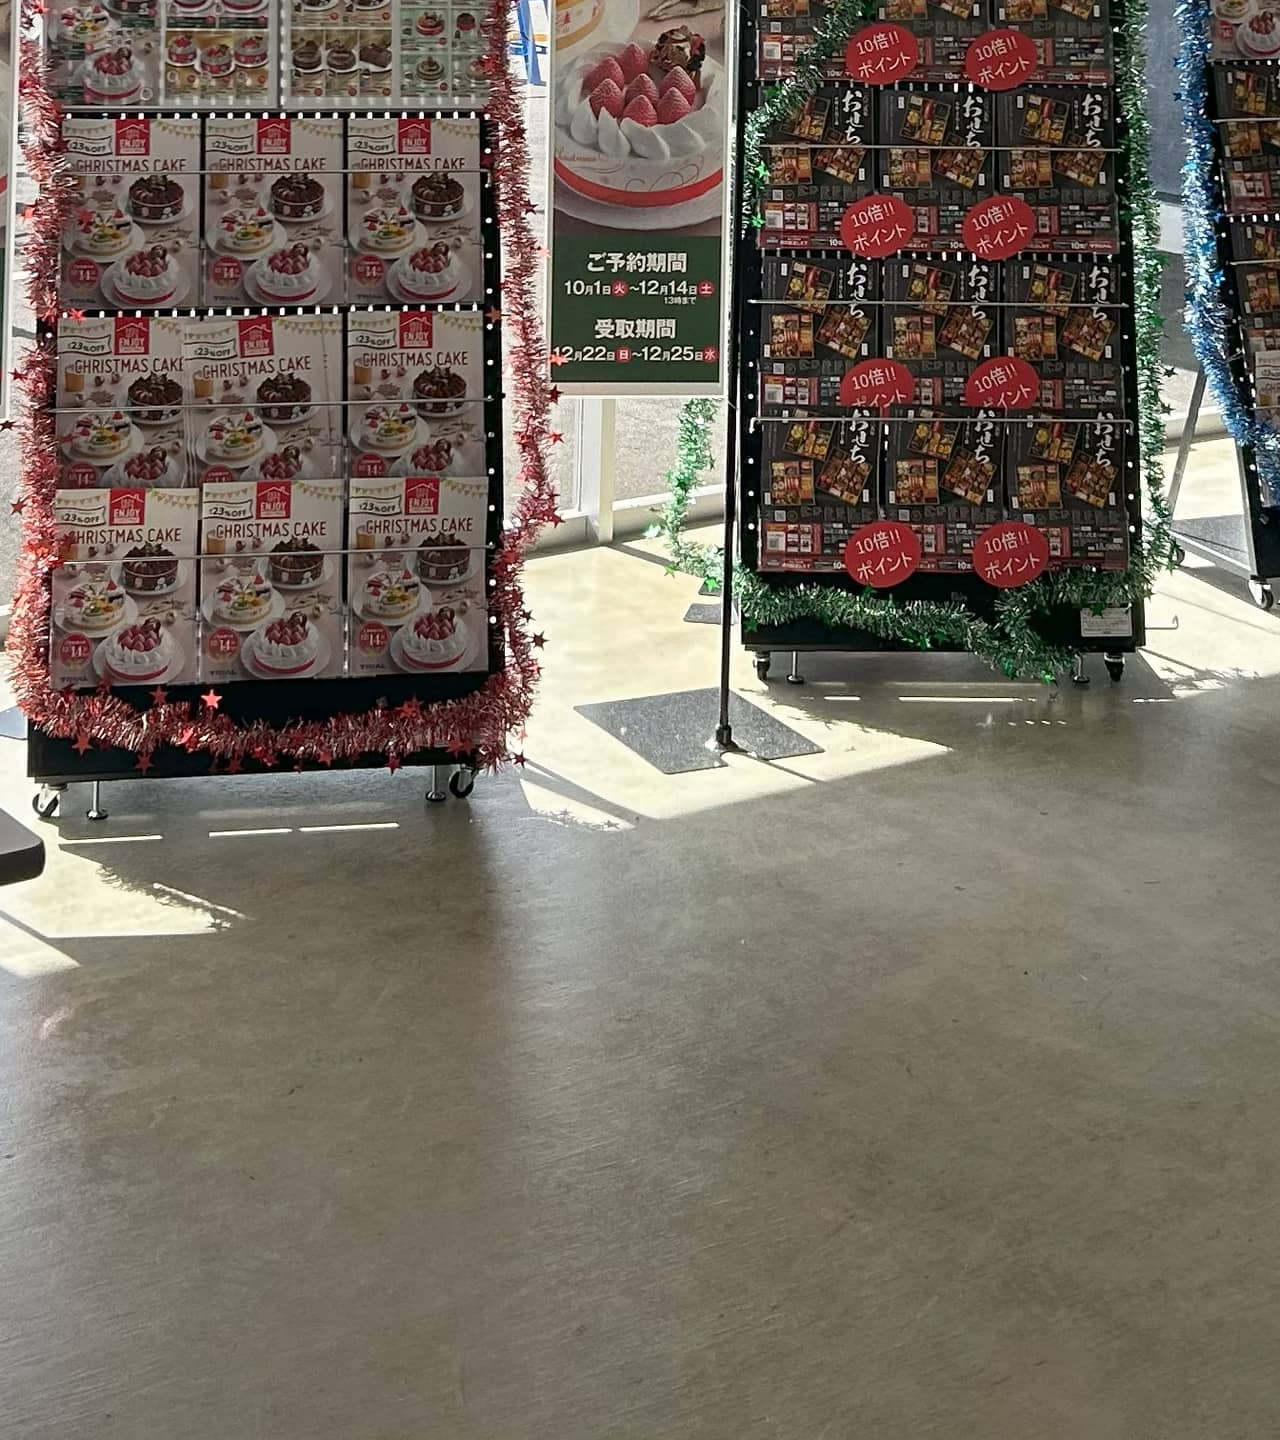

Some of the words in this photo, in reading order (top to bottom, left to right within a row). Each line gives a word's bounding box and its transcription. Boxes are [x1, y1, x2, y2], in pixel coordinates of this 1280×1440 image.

[858, 52, 911, 77] ポイント
[977, 58, 1030, 83] ポイント
[77, 160, 149, 172] CHRISTMAS
[153, 159, 186, 171] CAKE
[220, 159, 289, 172] CHRISTMAS
[294, 158, 328, 170] CAKE
[361, 159, 430, 170] CHRISTMAS
[435, 158, 465, 169] CAKE
[853, 224, 907, 251] ポイント
[975, 223, 1028, 251] ポイント
[586, 252, 688, 273] ご予約期間
[663, 296, 697, 305] 13時まで
[594, 318, 677, 340] 受取期間
[75, 360, 149, 374] CHRISTMAS
[202, 360, 274, 379] CHRISTMAS
[279, 356, 311, 372] CAKE
[363, 353, 432, 367] CHRISTMAS
[437, 352, 469, 365] CAKE
[148, 528, 181, 542] CAKE
[216, 523, 288, 539] CHRISTMAS
[294, 521, 327, 536] CAKE
[366, 519, 437, 534] CHRISTMAS
[442, 518, 473, 532] CAKE
[857, 556, 912, 581] ポイント
[985, 556, 1040, 580] ポイント
